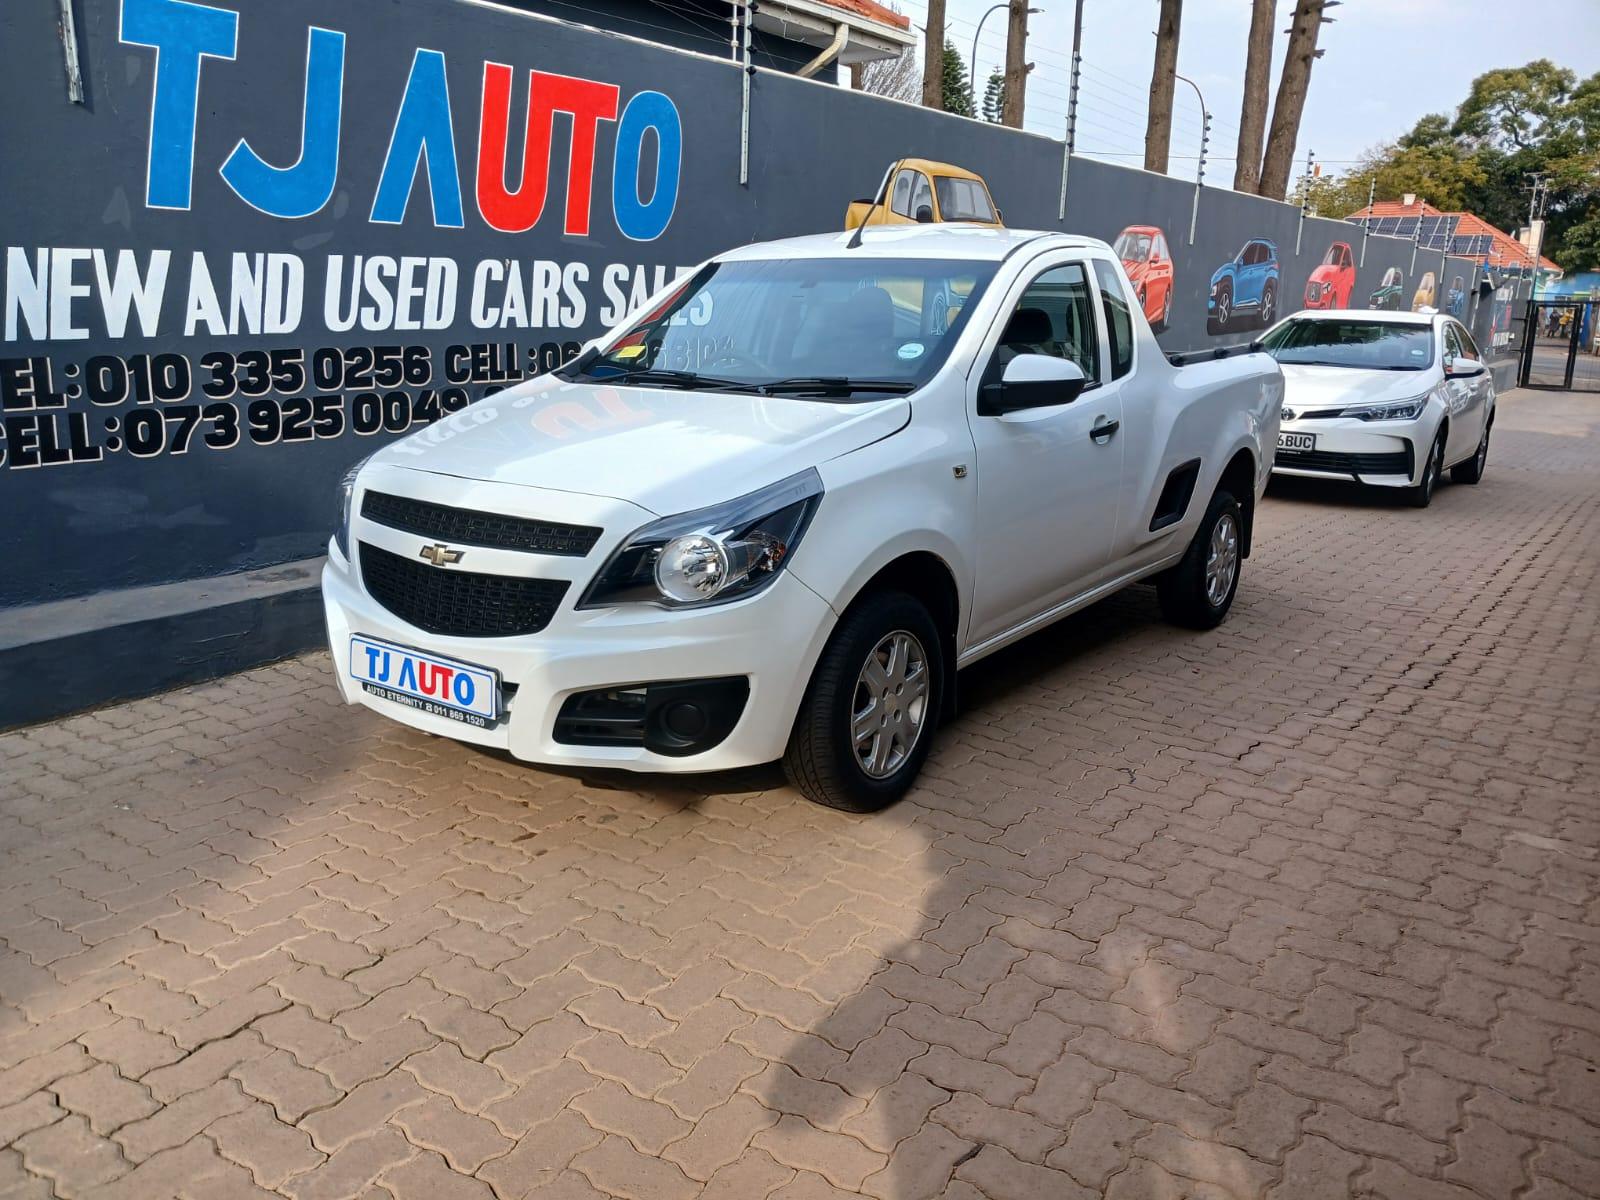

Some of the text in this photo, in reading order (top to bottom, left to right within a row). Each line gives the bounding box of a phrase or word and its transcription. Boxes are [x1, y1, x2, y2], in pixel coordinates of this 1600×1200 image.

[119, 0, 682, 242] TJ AUTO
[4, 246, 171, 342] NEW
[184, 250, 304, 336] AND
[323, 254, 456, 331] USED
[471, 259, 589, 329] CARS
[0, 353, 192, 412] EL:010
[200, 349, 306, 400] 335
[313, 346, 432, 392] 0256
[445, 341, 583, 385] CELL:06
[248, 394, 345, 446] 925
[365, 646, 475, 706] TJ AUTO
[366, 684, 485, 727] AUTO ETERNITY 011 869 1520
